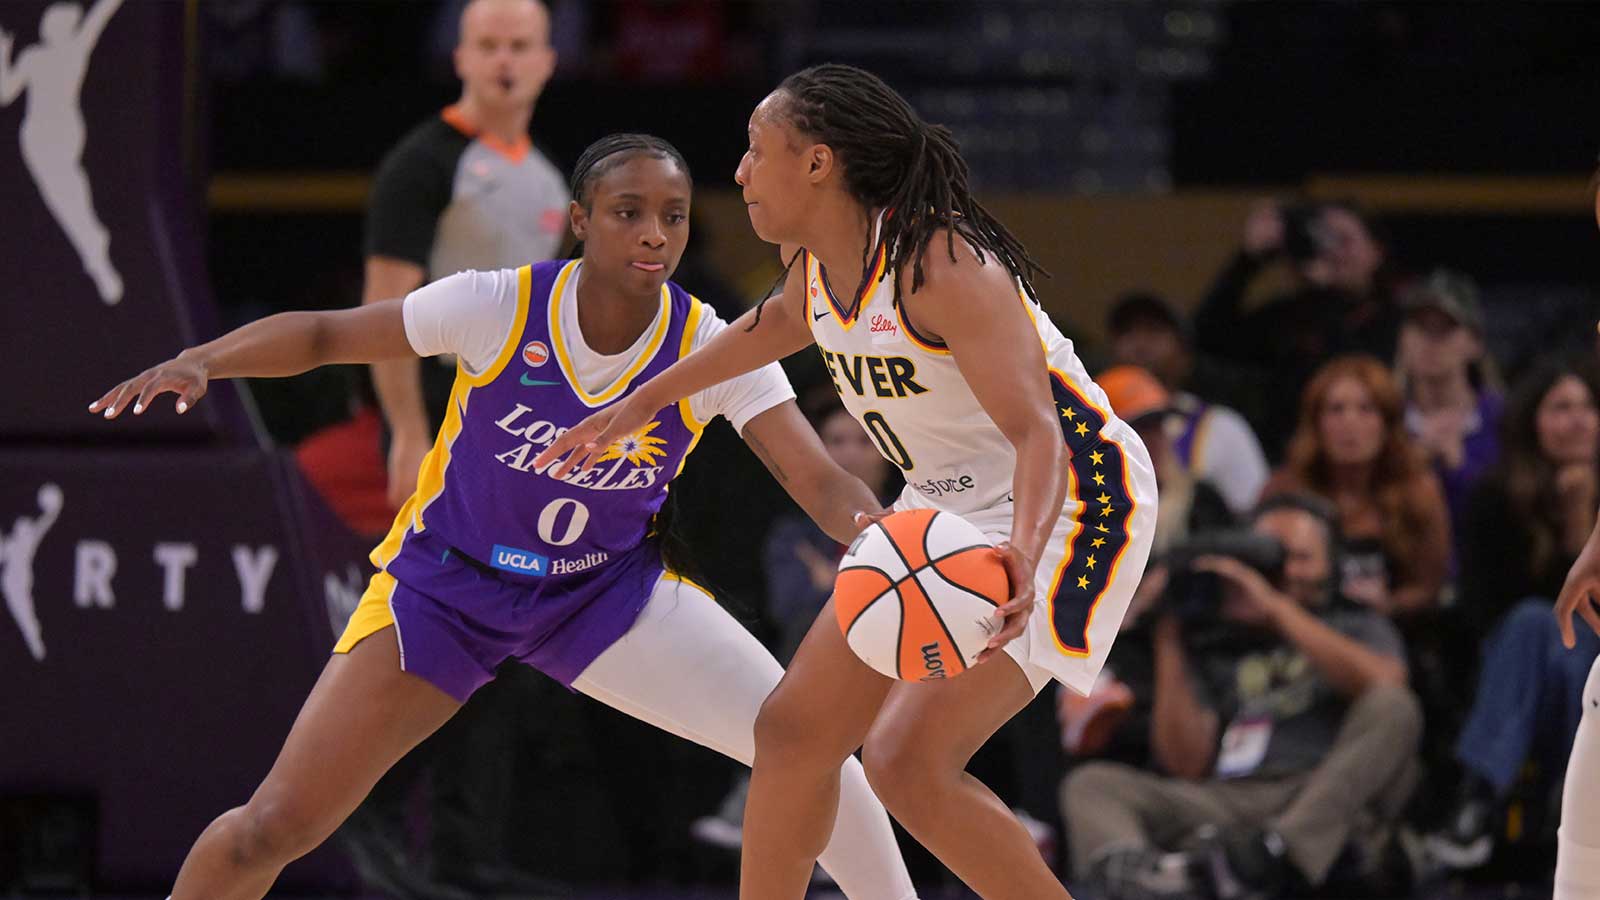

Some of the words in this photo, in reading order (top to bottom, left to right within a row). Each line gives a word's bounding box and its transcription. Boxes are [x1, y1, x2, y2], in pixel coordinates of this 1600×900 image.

[870, 314, 898, 336] Lilly
[819, 346, 931, 398] EVER
[864, 411, 914, 471] 0
[537, 498, 590, 546] 0
[497, 552, 541, 571] UCLA
[551, 552, 609, 575] Health
